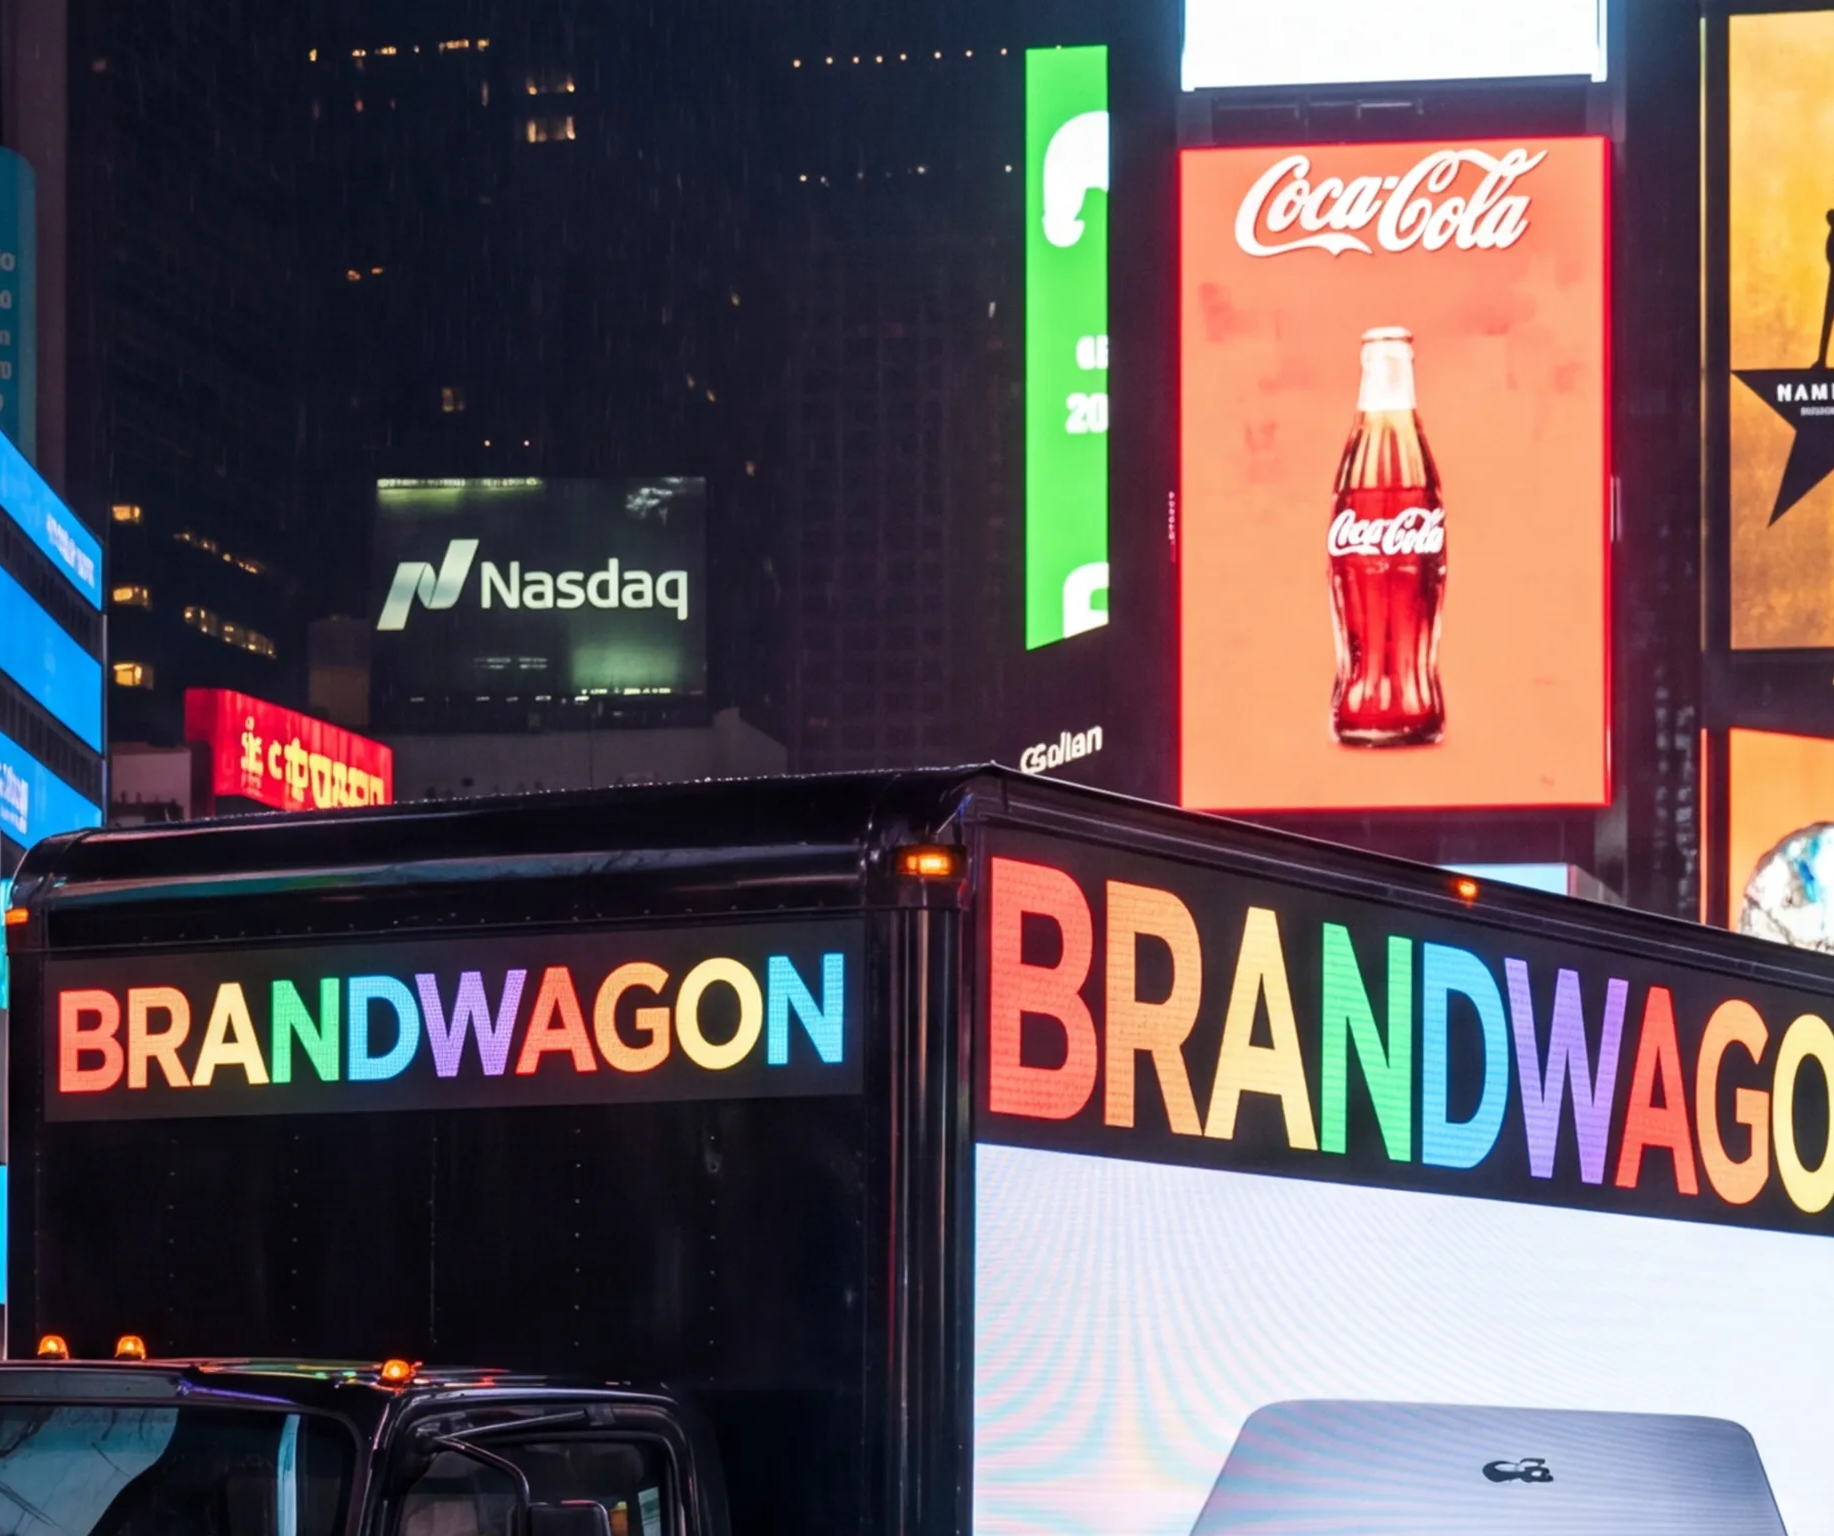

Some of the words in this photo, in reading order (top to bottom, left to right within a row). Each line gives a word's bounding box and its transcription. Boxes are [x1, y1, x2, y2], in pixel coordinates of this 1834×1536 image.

[1235, 148, 1548, 258] Coca-Cola
[481, 557, 688, 620] Nasdaq
[58, 953, 845, 1093] BRANDWAGON
